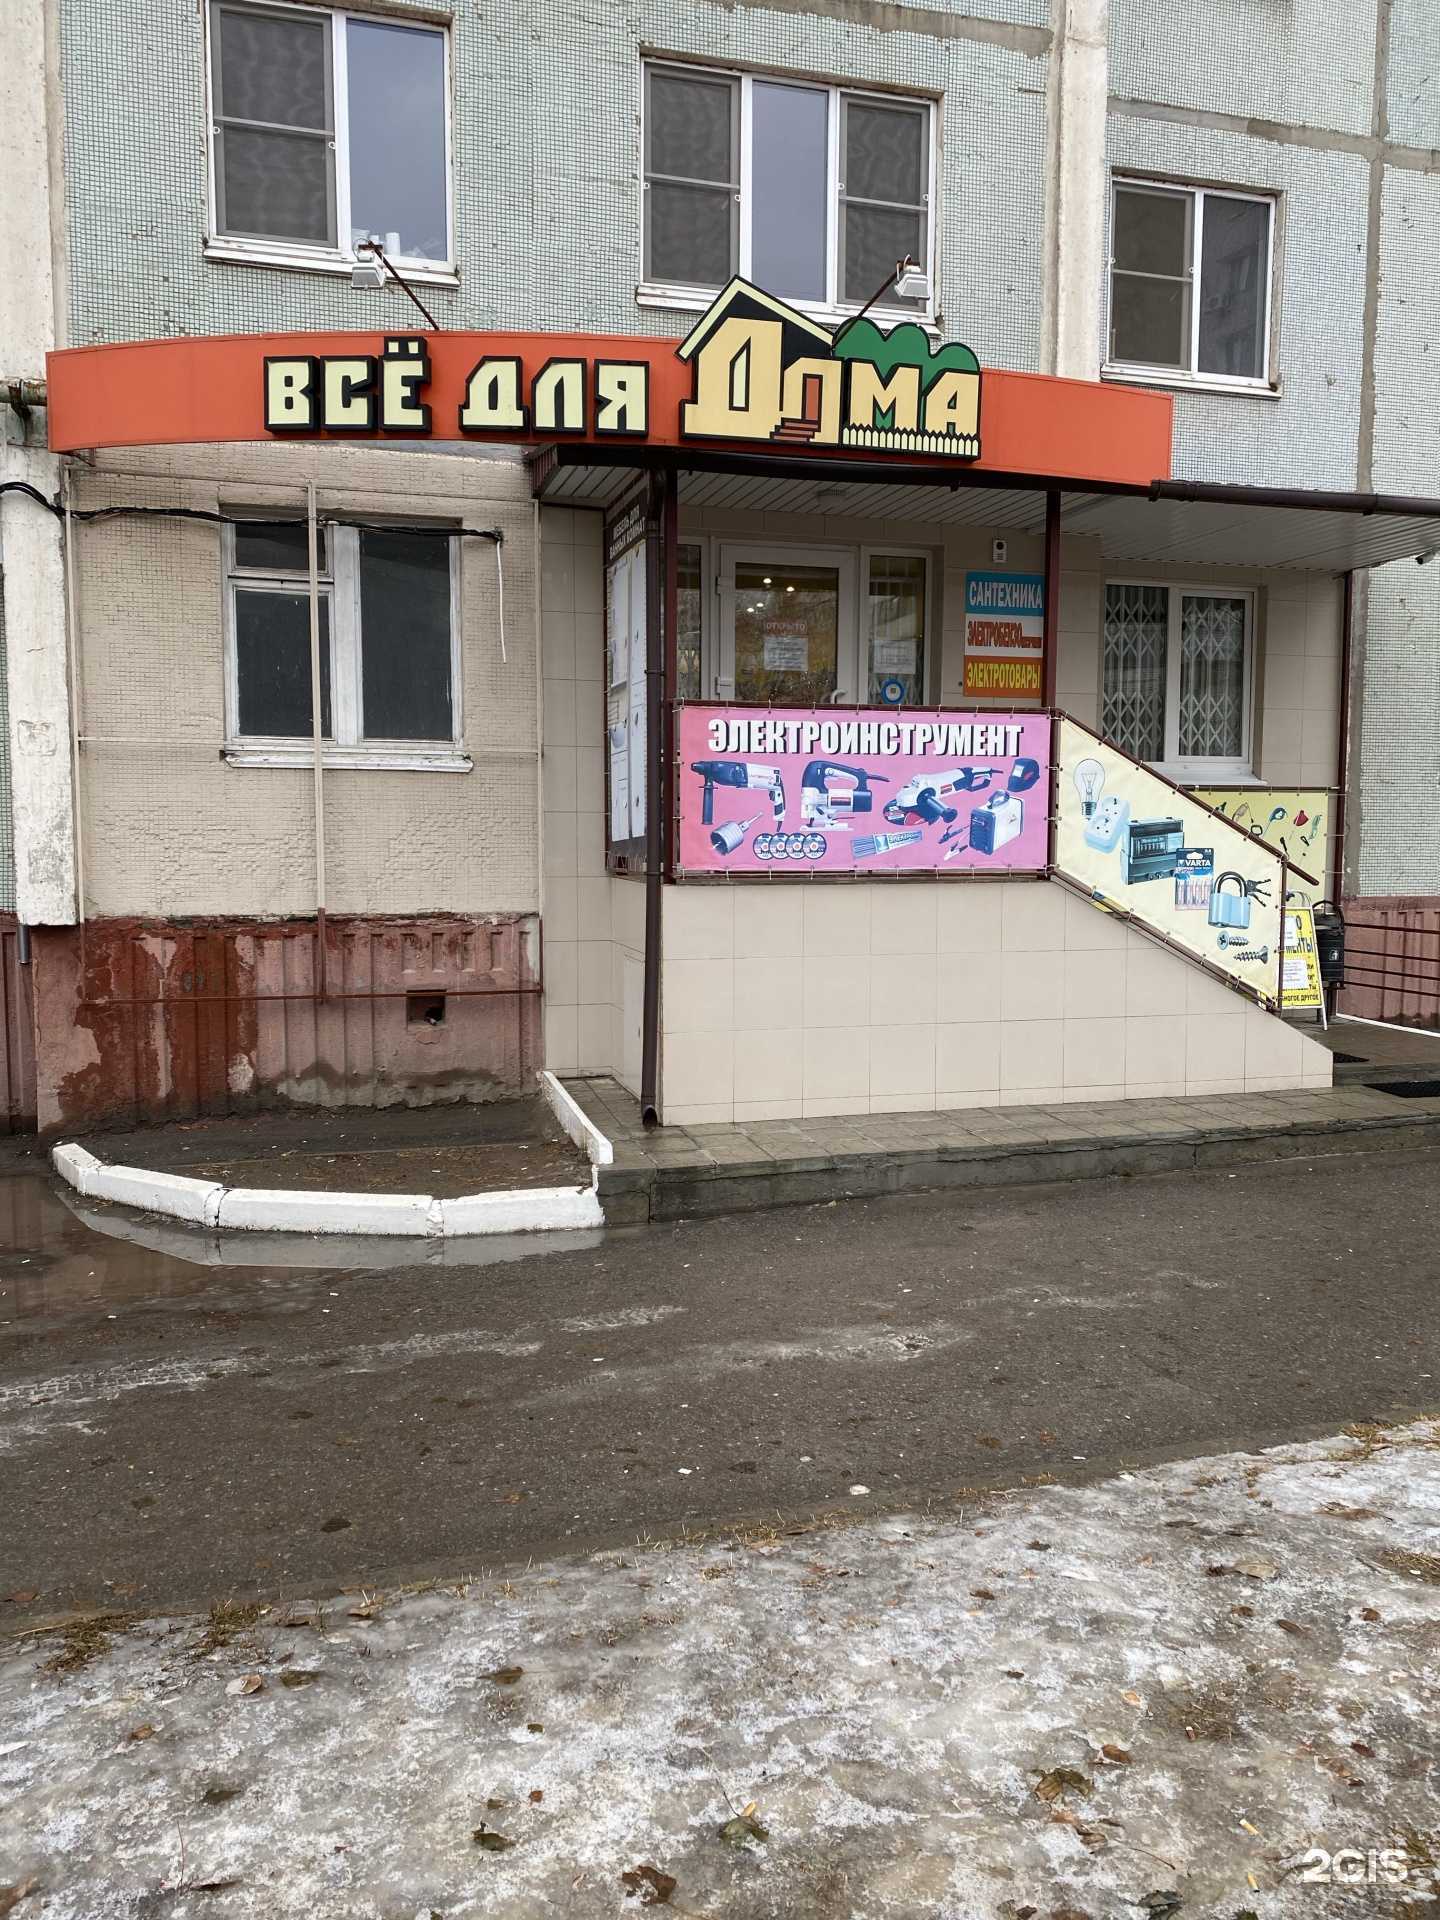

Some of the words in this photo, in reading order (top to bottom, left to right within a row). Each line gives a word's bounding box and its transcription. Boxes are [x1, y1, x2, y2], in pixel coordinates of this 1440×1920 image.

[264, 336, 432, 433] ВСЁ
[458, 355, 650, 436] ДЛЯ
[969, 581, 1043, 609] САНТЕХНИКА
[966, 662, 1041, 689] ЭЛЕКТРОТОВАРЫ
[707, 718, 1024, 758] ЭЛЕКТРОИНСТРУМЕНТ
[1185, 859, 1211, 867] VARTA
